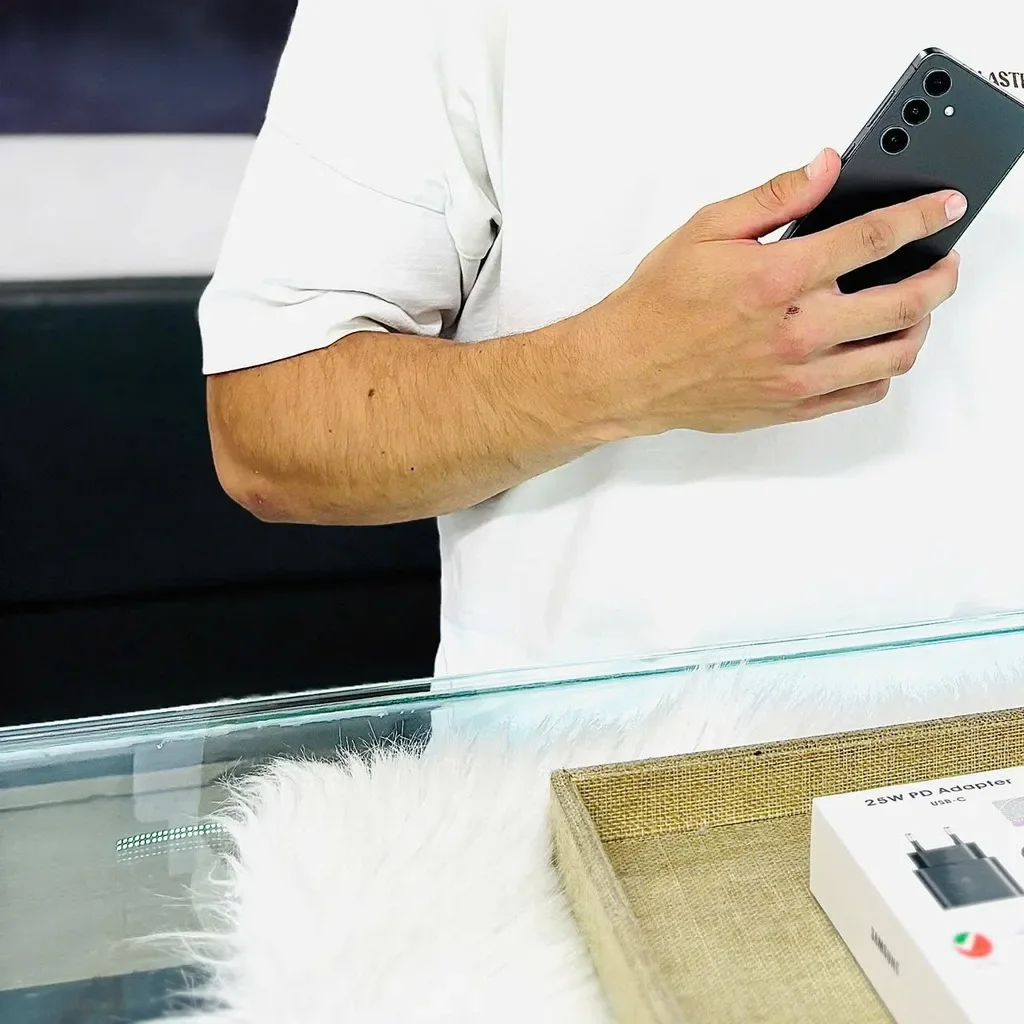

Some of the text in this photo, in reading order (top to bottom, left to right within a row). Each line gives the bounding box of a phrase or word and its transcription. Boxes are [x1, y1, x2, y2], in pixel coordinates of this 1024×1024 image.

[865, 779, 1012, 807] 25W PD Adapter
[930, 796, 967, 807] USB-C
